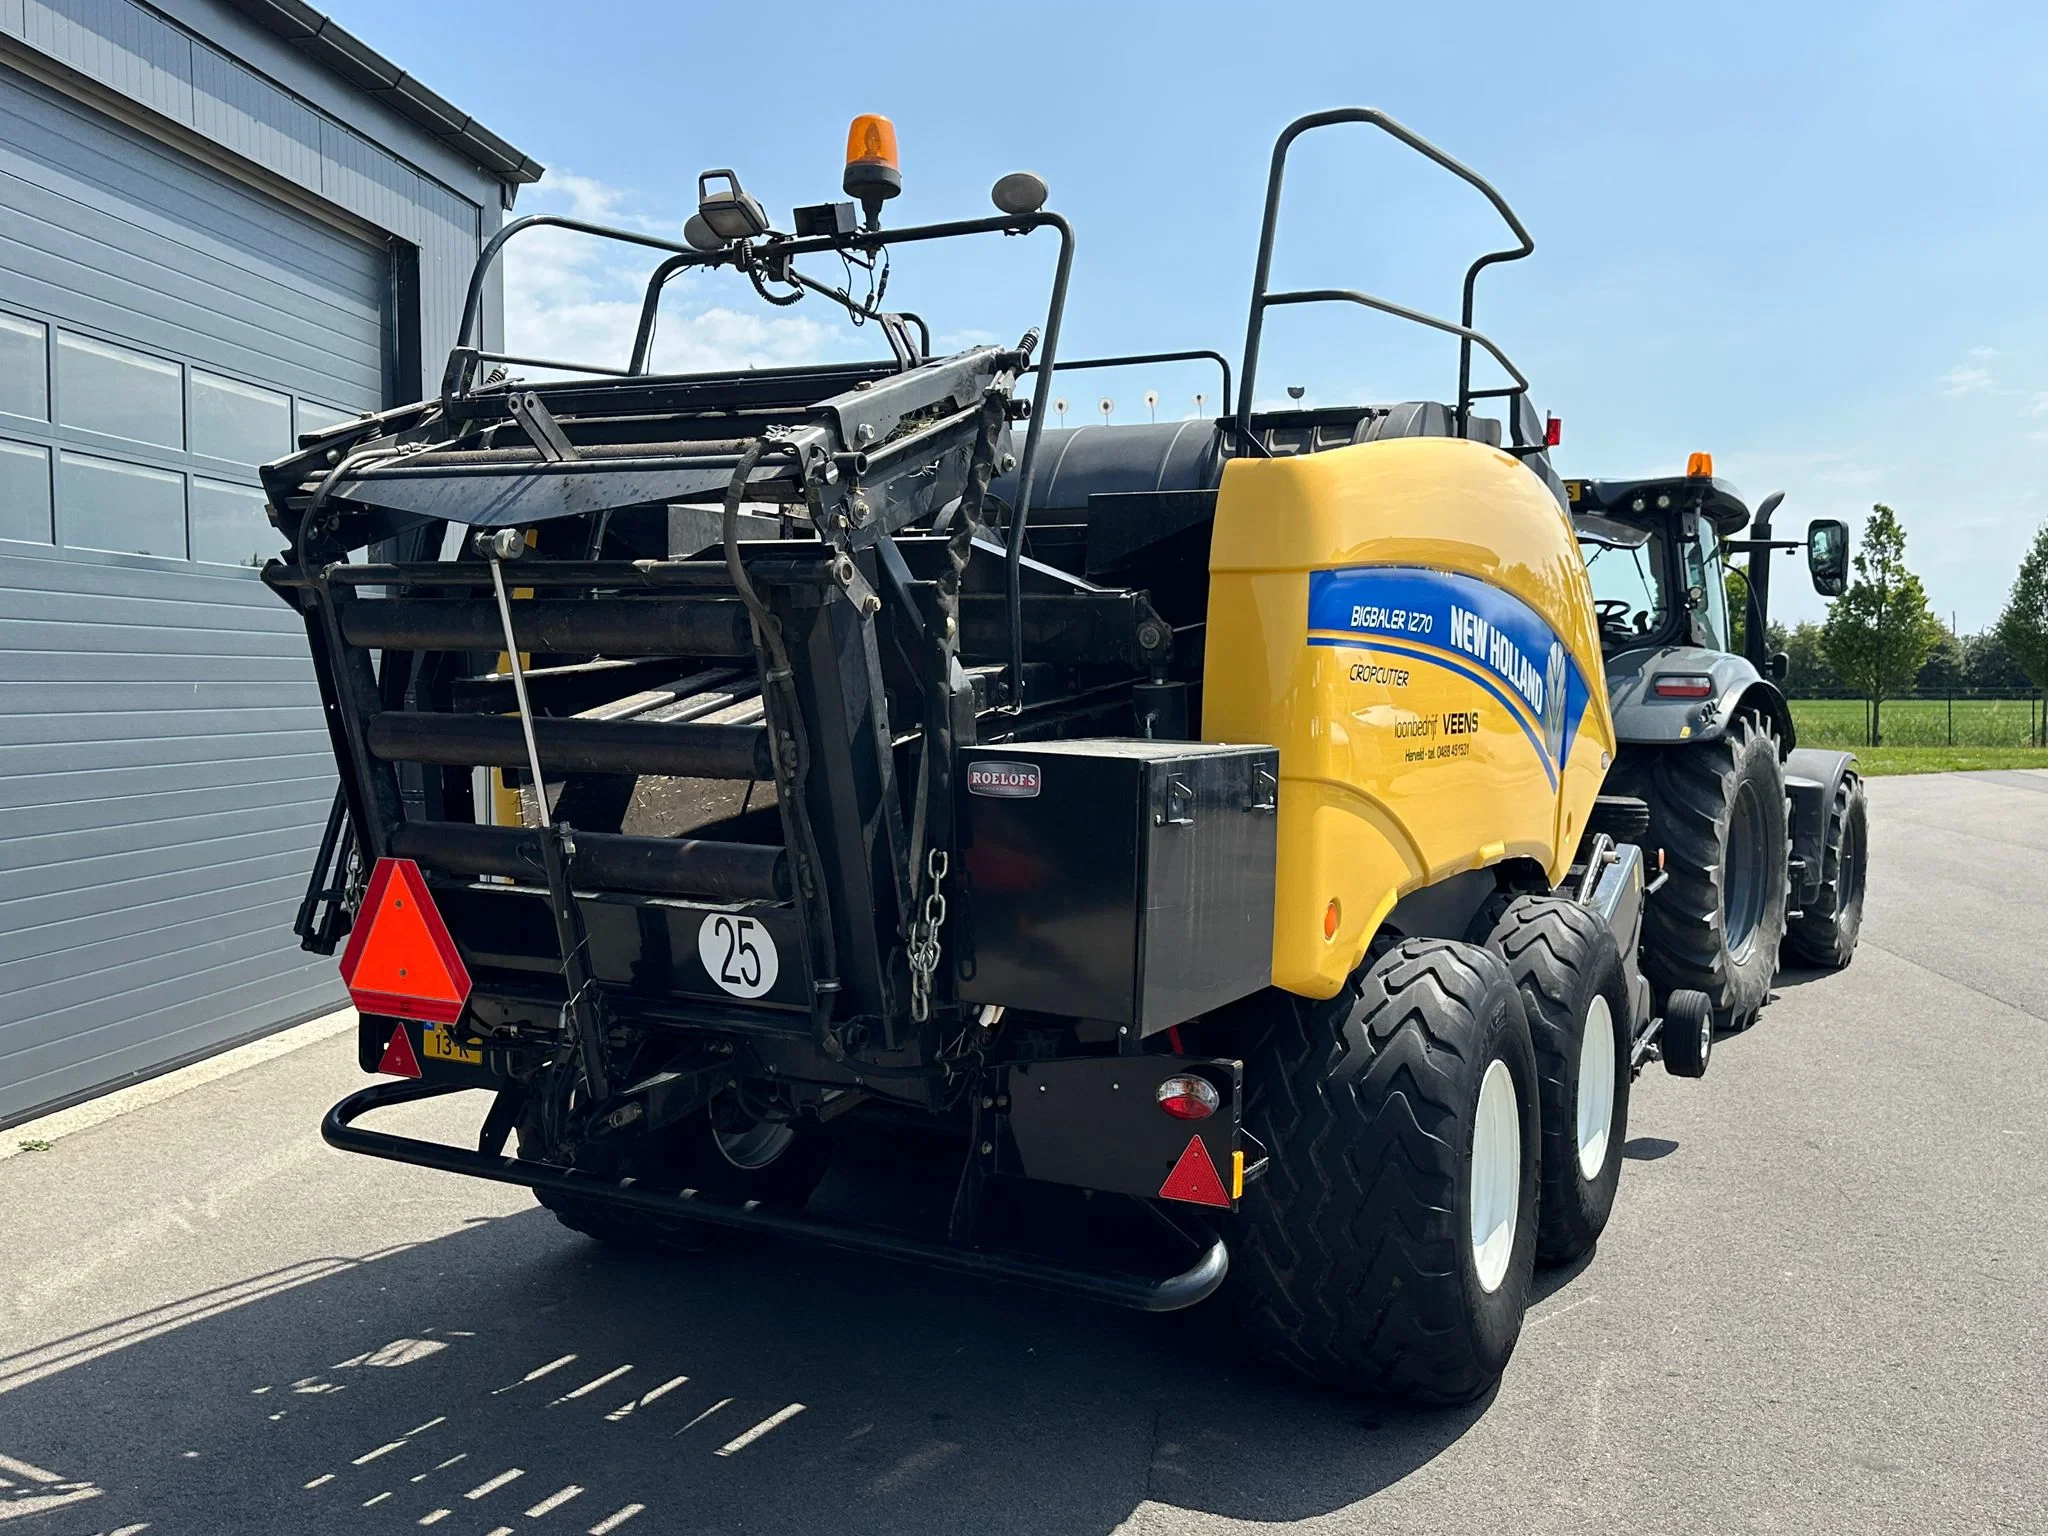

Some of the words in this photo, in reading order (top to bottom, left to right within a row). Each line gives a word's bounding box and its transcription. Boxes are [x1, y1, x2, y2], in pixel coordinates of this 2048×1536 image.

[1351, 605, 1406, 630] BIGBALER
[1407, 611, 1433, 634] 1270
[1450, 604, 1488, 661] NEW
[1489, 625, 1543, 716] HOLLAND
[1349, 664, 1409, 686] CROPCUTTER
[1394, 714, 1438, 741] loonbedrijf
[1442, 712, 1479, 735] VEENS
[972, 772, 1036, 786] ROELOFS
[715, 916, 761, 988] 25
